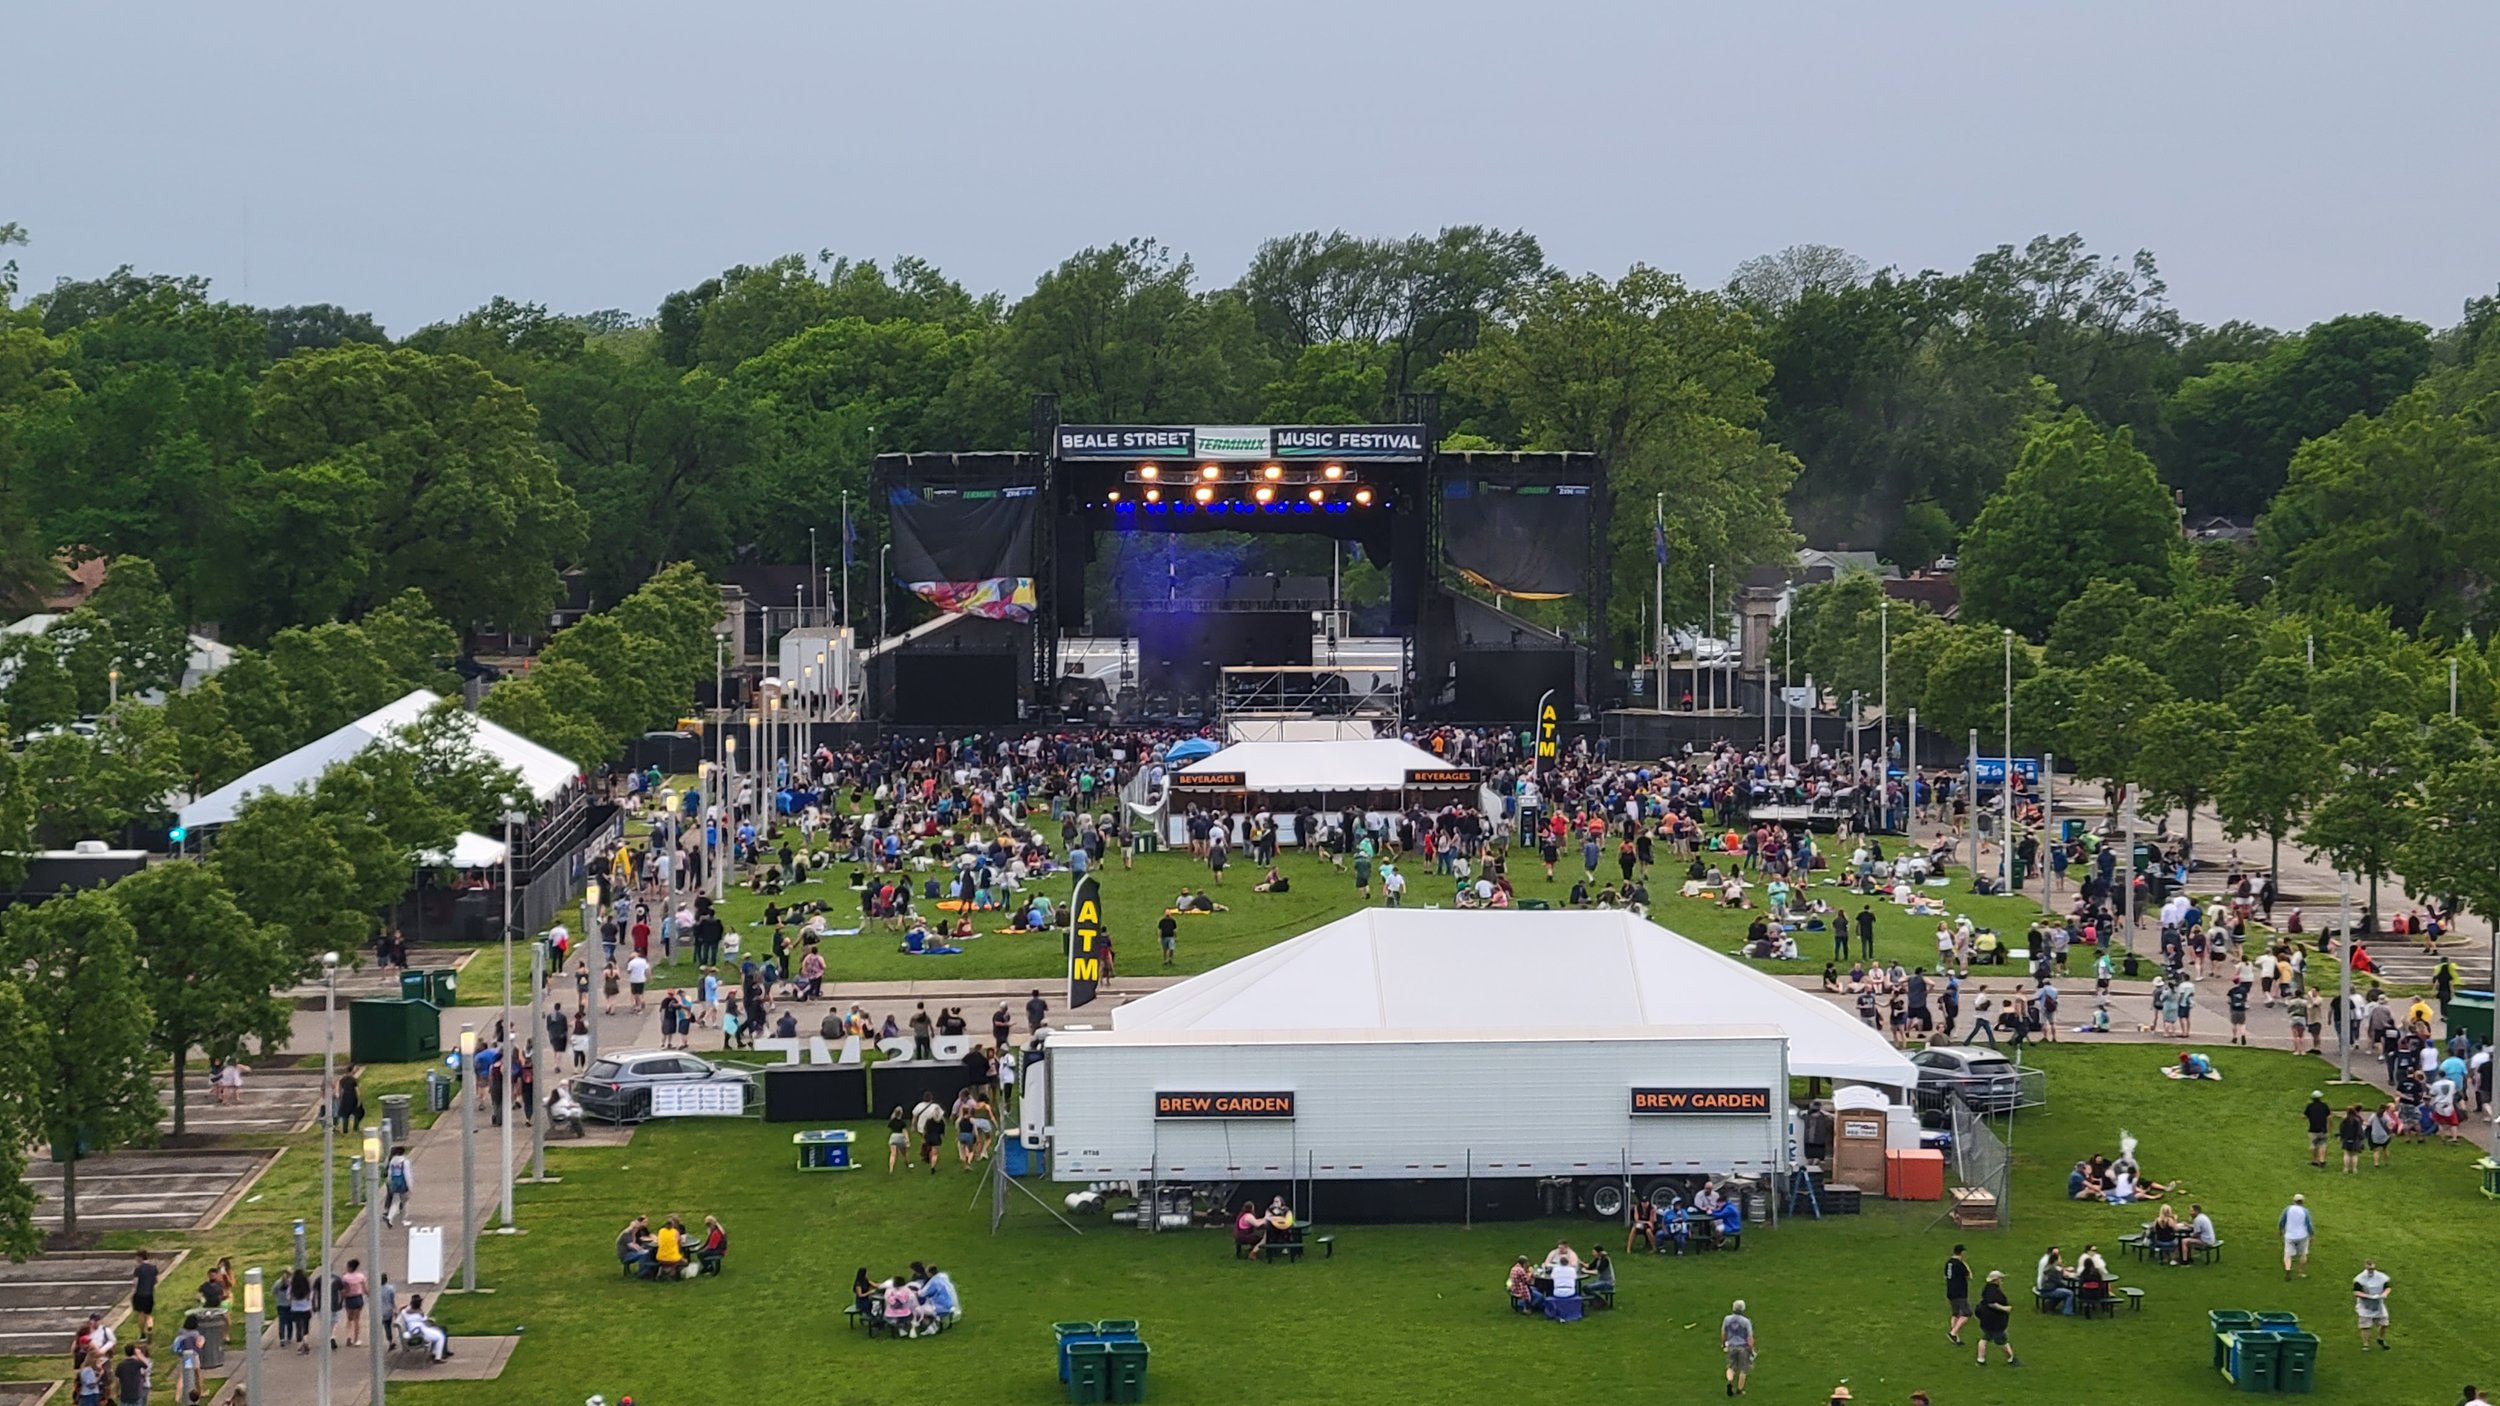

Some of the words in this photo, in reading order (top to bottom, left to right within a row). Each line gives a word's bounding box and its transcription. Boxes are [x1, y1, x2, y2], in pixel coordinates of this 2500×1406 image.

[1062, 434, 1118, 448] BEALE
[1124, 432, 1190, 446] STREET
[1198, 437, 1266, 451] TERMINIX
[1278, 432, 1333, 447] MUSIC
[1339, 433, 1422, 449] FESTIVAL
[1539, 705, 1557, 757] ATM
[1179, 775, 1236, 784] BEVERAGES
[1414, 772, 1471, 781] BEVERAGES
[1073, 900, 1099, 981] ATM
[1160, 1098, 1211, 1111] BREW
[1215, 1098, 1289, 1111] GARDEN
[1635, 1094, 1687, 1107] BREW
[1691, 1094, 1765, 1107] GARDEN
